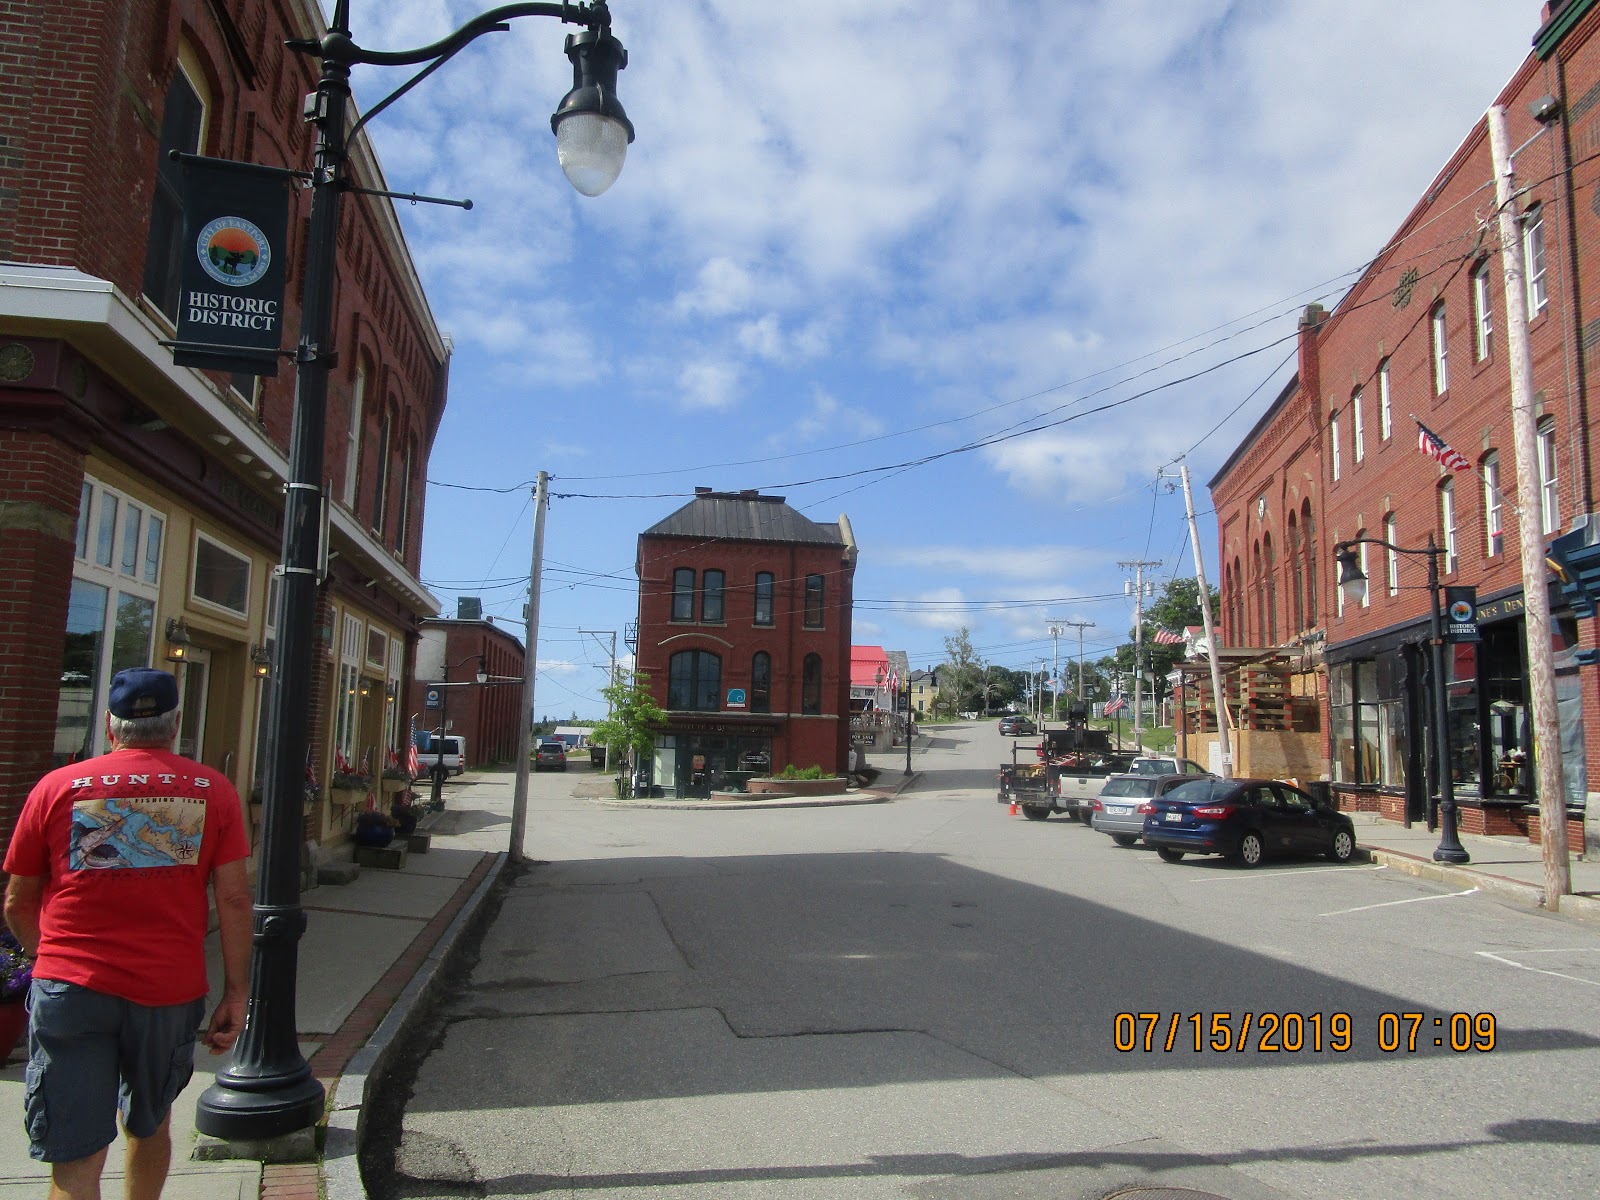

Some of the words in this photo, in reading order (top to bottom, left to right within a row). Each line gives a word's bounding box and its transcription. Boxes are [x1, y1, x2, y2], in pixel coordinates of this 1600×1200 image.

[202, 227, 215, 246] CITY
[215, 221, 227, 229] OF
[229, 219, 267, 250] EASTPORT
[188, 291, 277, 315] HISTORIC
[188, 307, 275, 331] DISTRICT
[71, 773, 211, 789] HUNT'S
